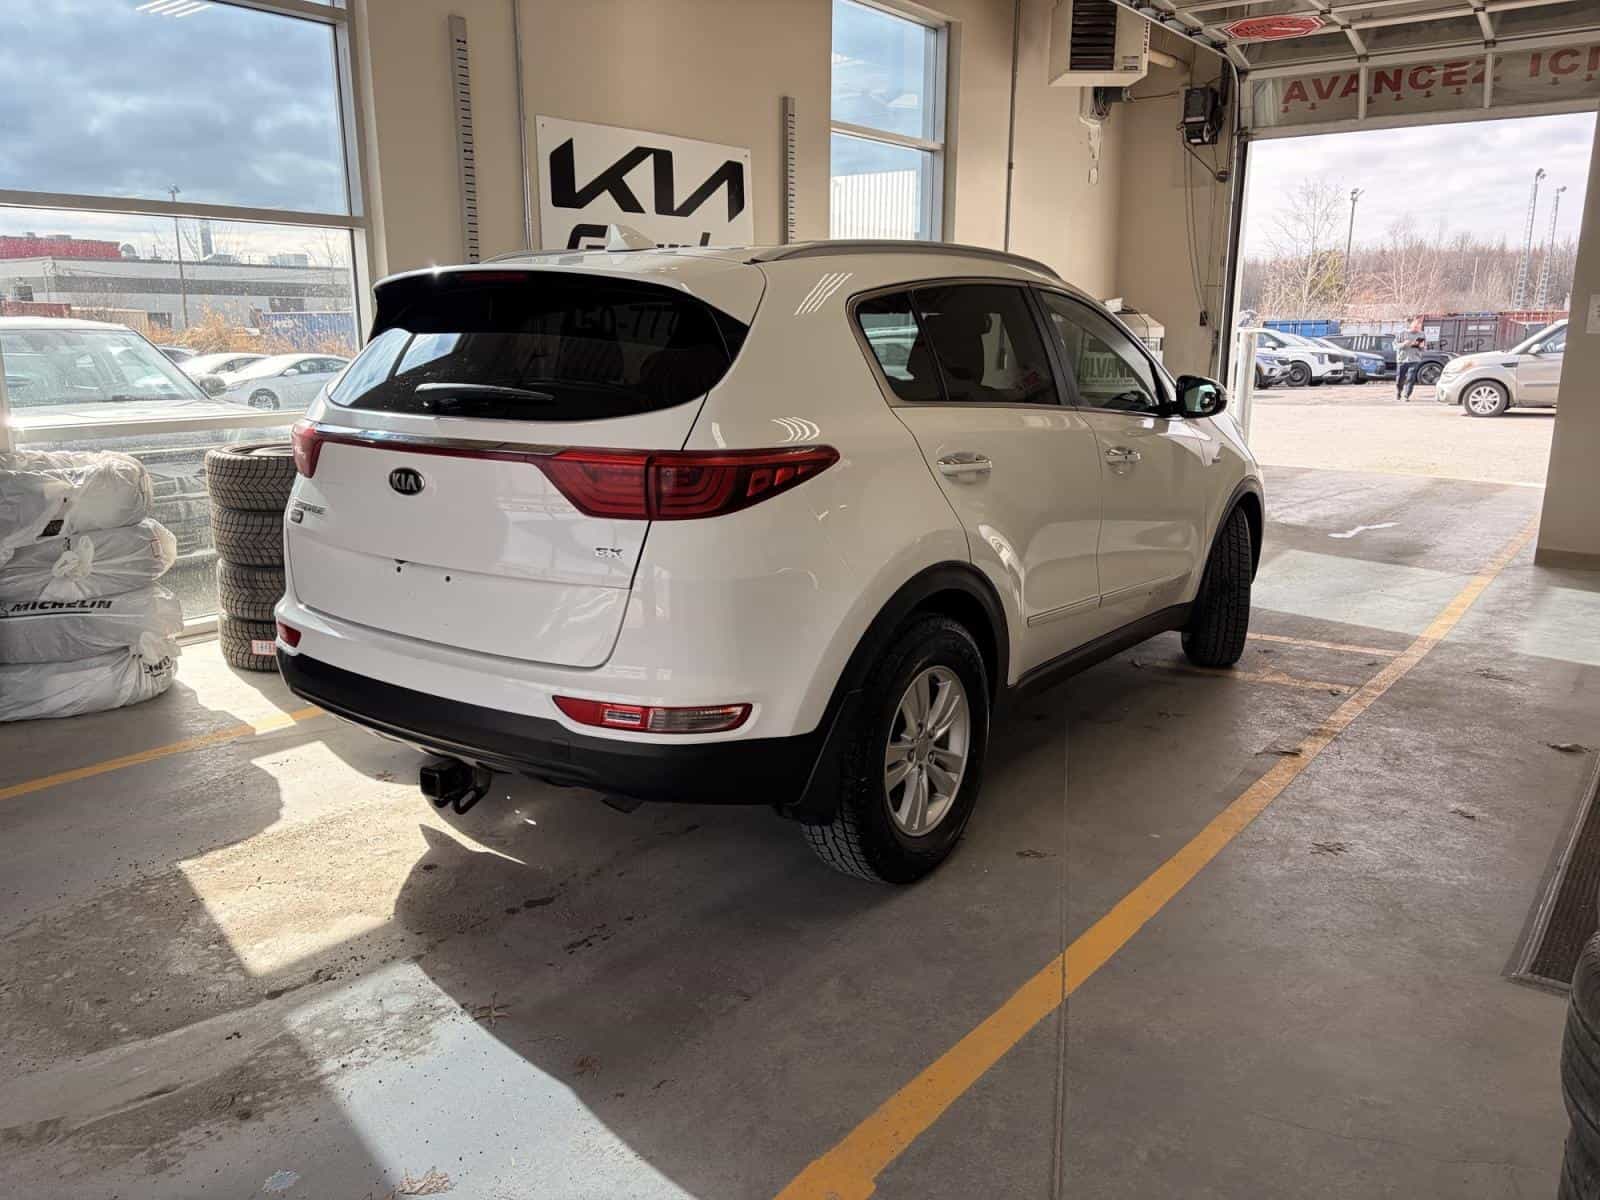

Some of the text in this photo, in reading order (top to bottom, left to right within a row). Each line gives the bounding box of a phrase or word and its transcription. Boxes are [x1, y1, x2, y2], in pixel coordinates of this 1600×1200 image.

[550, 137, 745, 222] KIA
[391, 472, 418, 491] KIA
[10, 599, 113, 612] MICHELIN
